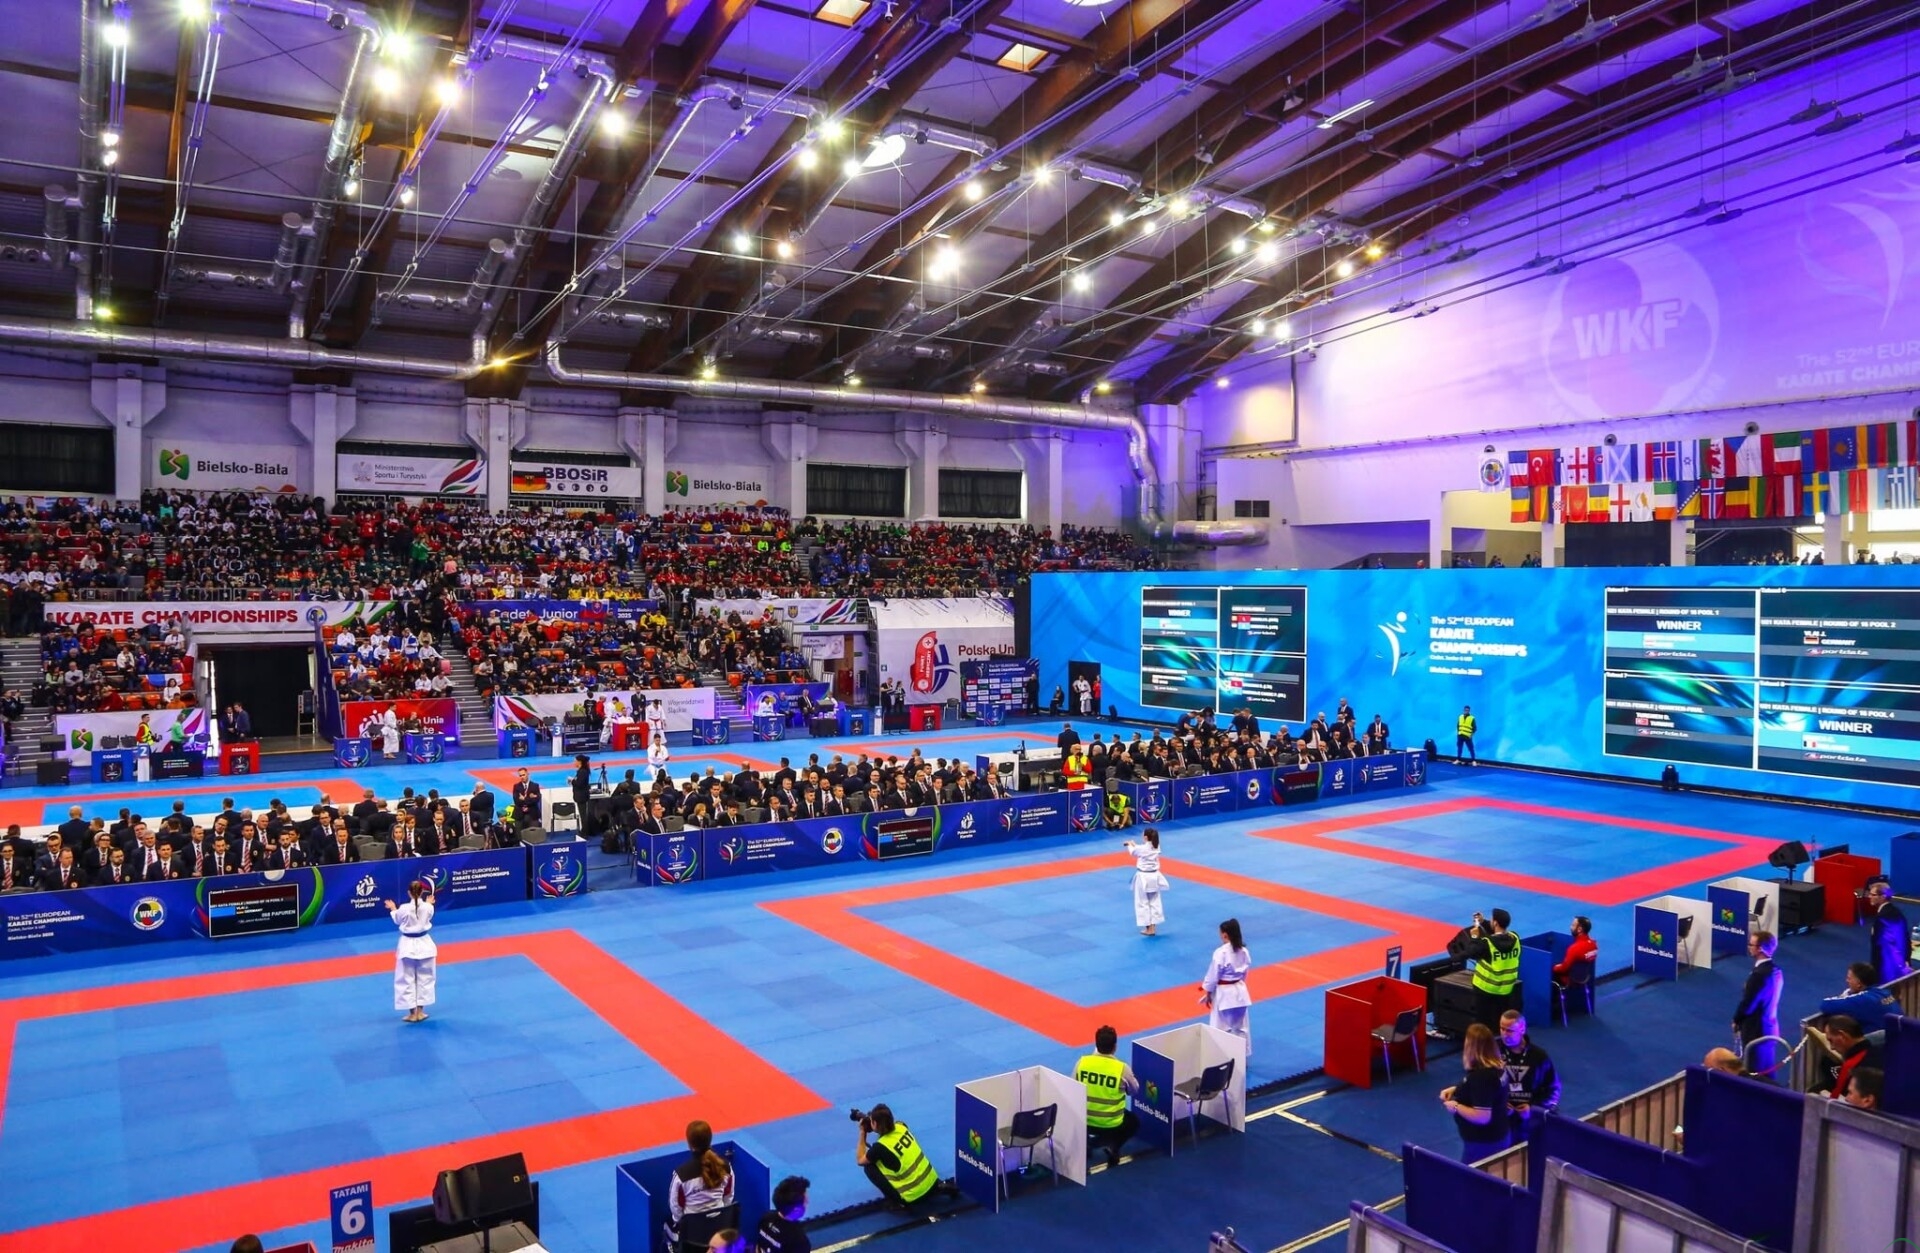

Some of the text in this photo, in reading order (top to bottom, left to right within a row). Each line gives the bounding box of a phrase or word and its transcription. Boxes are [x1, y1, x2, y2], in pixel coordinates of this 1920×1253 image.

[1571, 297, 1682, 360] WKF
[1796, 352, 1831, 369] The
[1777, 369, 1846, 390] KARATE
[197, 460, 289, 476] Bielsko-Biała
[374, 464, 415, 472] Ministerstwo
[542, 466, 609, 482] BBOSiR
[374, 472, 395, 480] Sportu
[399, 472, 428, 480] Turystyki
[693, 479, 762, 493] Bielsko-Biała
[56, 608, 298, 625] KARATE CHAMPIONSHIPS
[539, 608, 579, 619] Junior
[1430, 616, 1446, 624] The
[1464, 617, 1514, 626] EUROPEAN
[1656, 619, 1702, 631] WINNER
[1429, 627, 1475, 640] KARATE
[1821, 638, 1856, 646] GERMANY
[958, 644, 997, 656] Polska
[1429, 641, 1528, 657] CHAMPIONSHIPS
[423, 716, 444, 724] Unia
[1868, 710, 1889, 718] POOL
[554, 726, 561, 736] 3
[1818, 719, 1873, 734] WINNER
[139, 746, 148, 757] 2
[668, 835, 686, 843] JUDGE
[551, 846, 570, 854] JUDGE
[471, 870, 510, 879] CHAMPIONSHIPS
[472, 866, 500, 874] EUROPEAN
[34, 910, 71, 919] EUROPEAN
[139, 909, 158, 918] WKF
[271, 909, 296, 917] PAPUREN
[33, 914, 85, 925] CHAMPIONSHIPS
[1493, 947, 1519, 962] FOTO
[1388, 955, 1399, 977] 7
[1080, 1070, 1117, 1089] FOTO
[1134, 1098, 1169, 1124] Bielsko-Biała
[958, 1148, 994, 1177] Bielsko-Biała
[332, 1183, 369, 1199] TATAMI
[340, 1198, 366, 1235] 6
